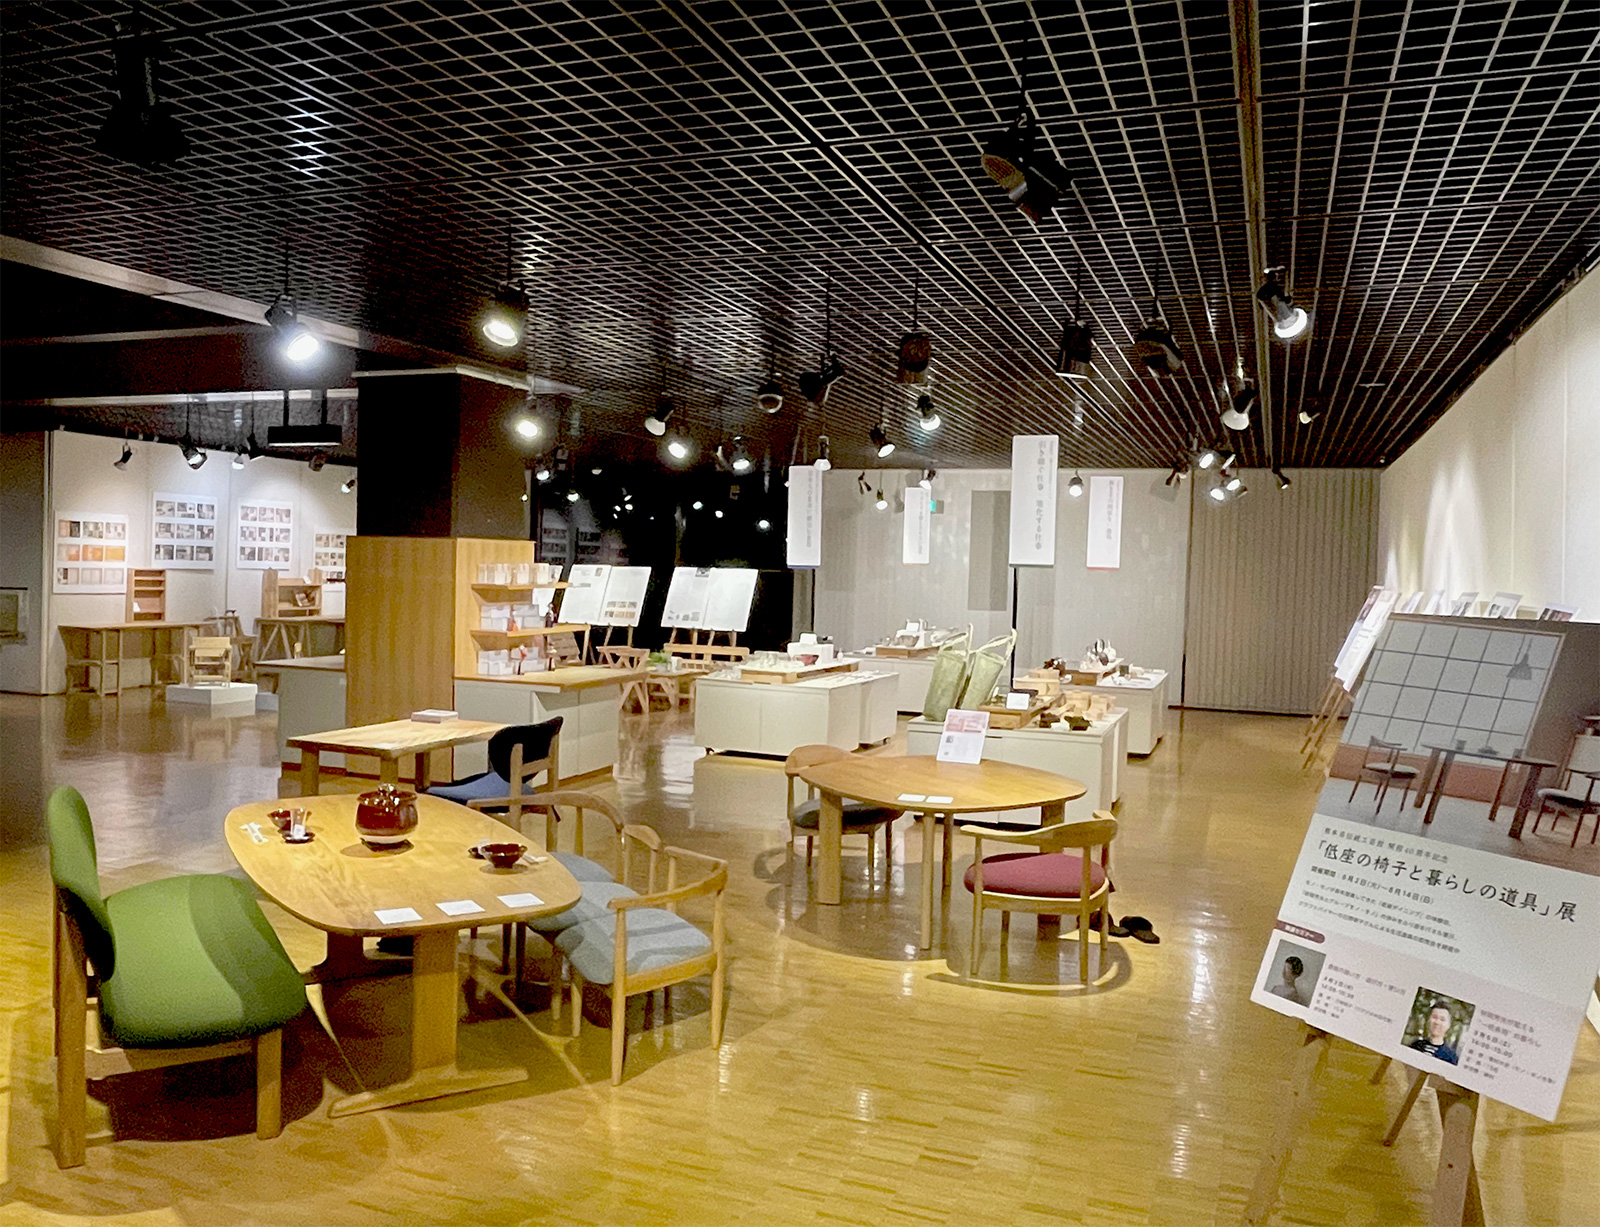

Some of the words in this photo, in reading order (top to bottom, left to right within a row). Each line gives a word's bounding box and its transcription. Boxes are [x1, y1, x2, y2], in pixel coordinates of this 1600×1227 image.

[1317, 840, 1577, 922] 「低座の椅子と暮らしの道具」展
